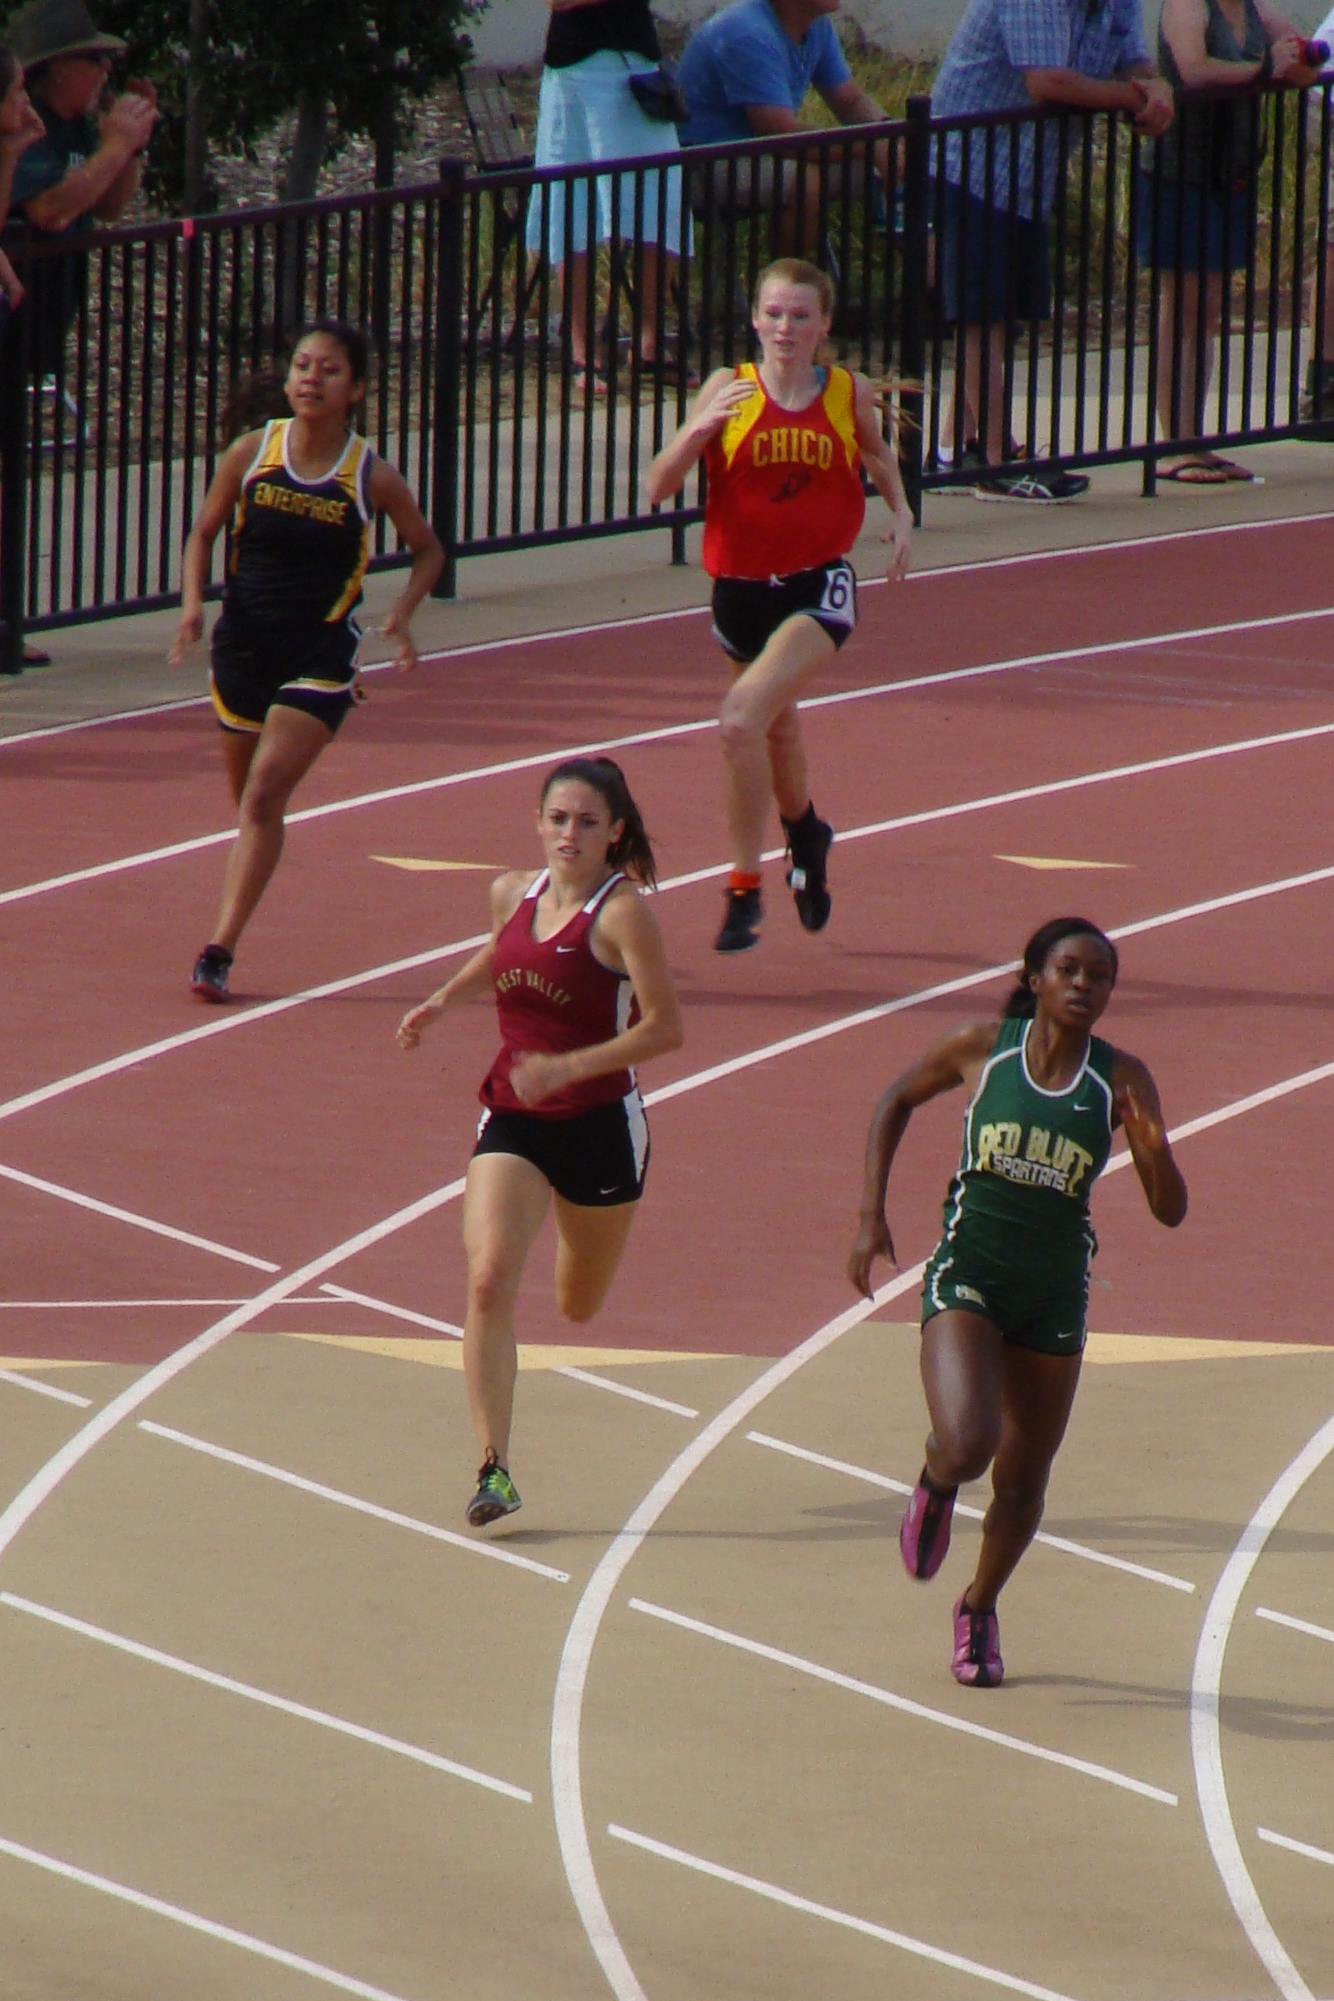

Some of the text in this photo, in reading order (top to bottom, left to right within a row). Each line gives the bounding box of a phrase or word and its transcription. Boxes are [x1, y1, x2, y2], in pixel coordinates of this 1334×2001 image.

[752, 427, 833, 471] CHICO
[254, 481, 348, 525] ENTERPRISE
[828, 570, 849, 609] 6
[525, 969, 572, 1006] VALLEY
[976, 1122, 1022, 1172] RED
[993, 1154, 1069, 1192] SPARTANS
